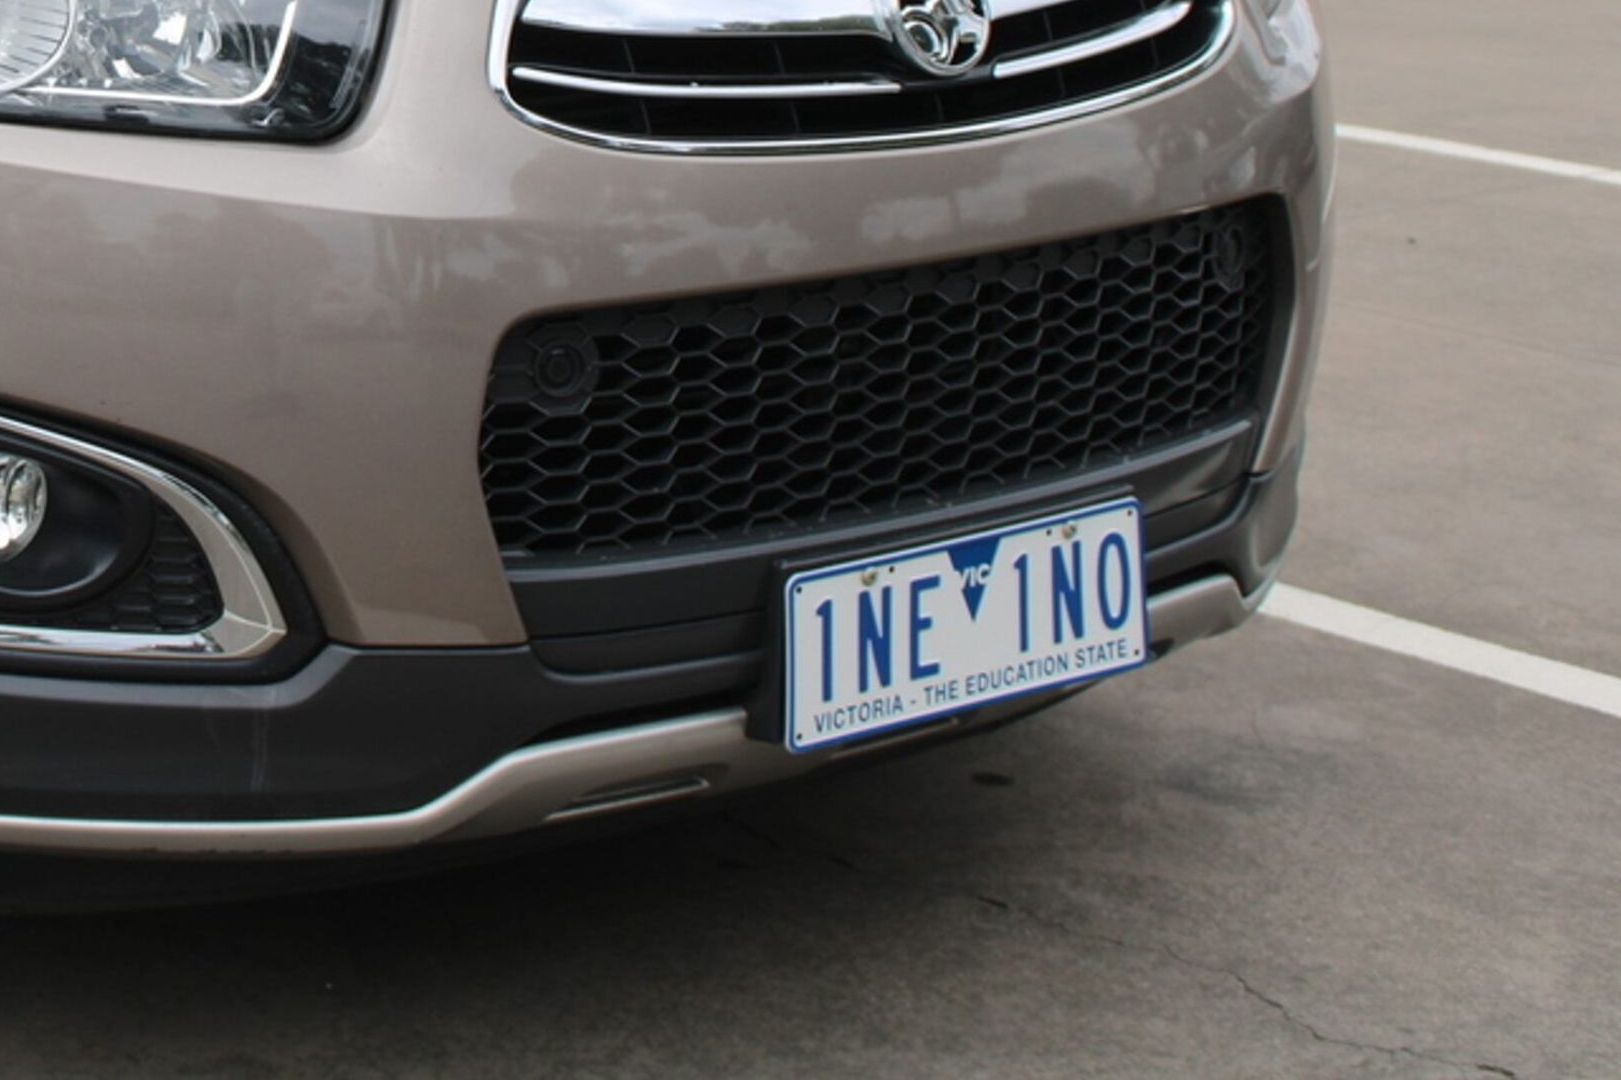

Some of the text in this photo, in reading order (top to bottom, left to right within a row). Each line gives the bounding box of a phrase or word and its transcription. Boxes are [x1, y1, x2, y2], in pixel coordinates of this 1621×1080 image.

[955, 562, 991, 587] VIC
[813, 694, 904, 733] VICTORIA
[923, 679, 959, 705] THE
[965, 652, 1069, 696] EDUCATION
[1074, 637, 1128, 669] STATE
[816, 574, 941, 703] 1NE
